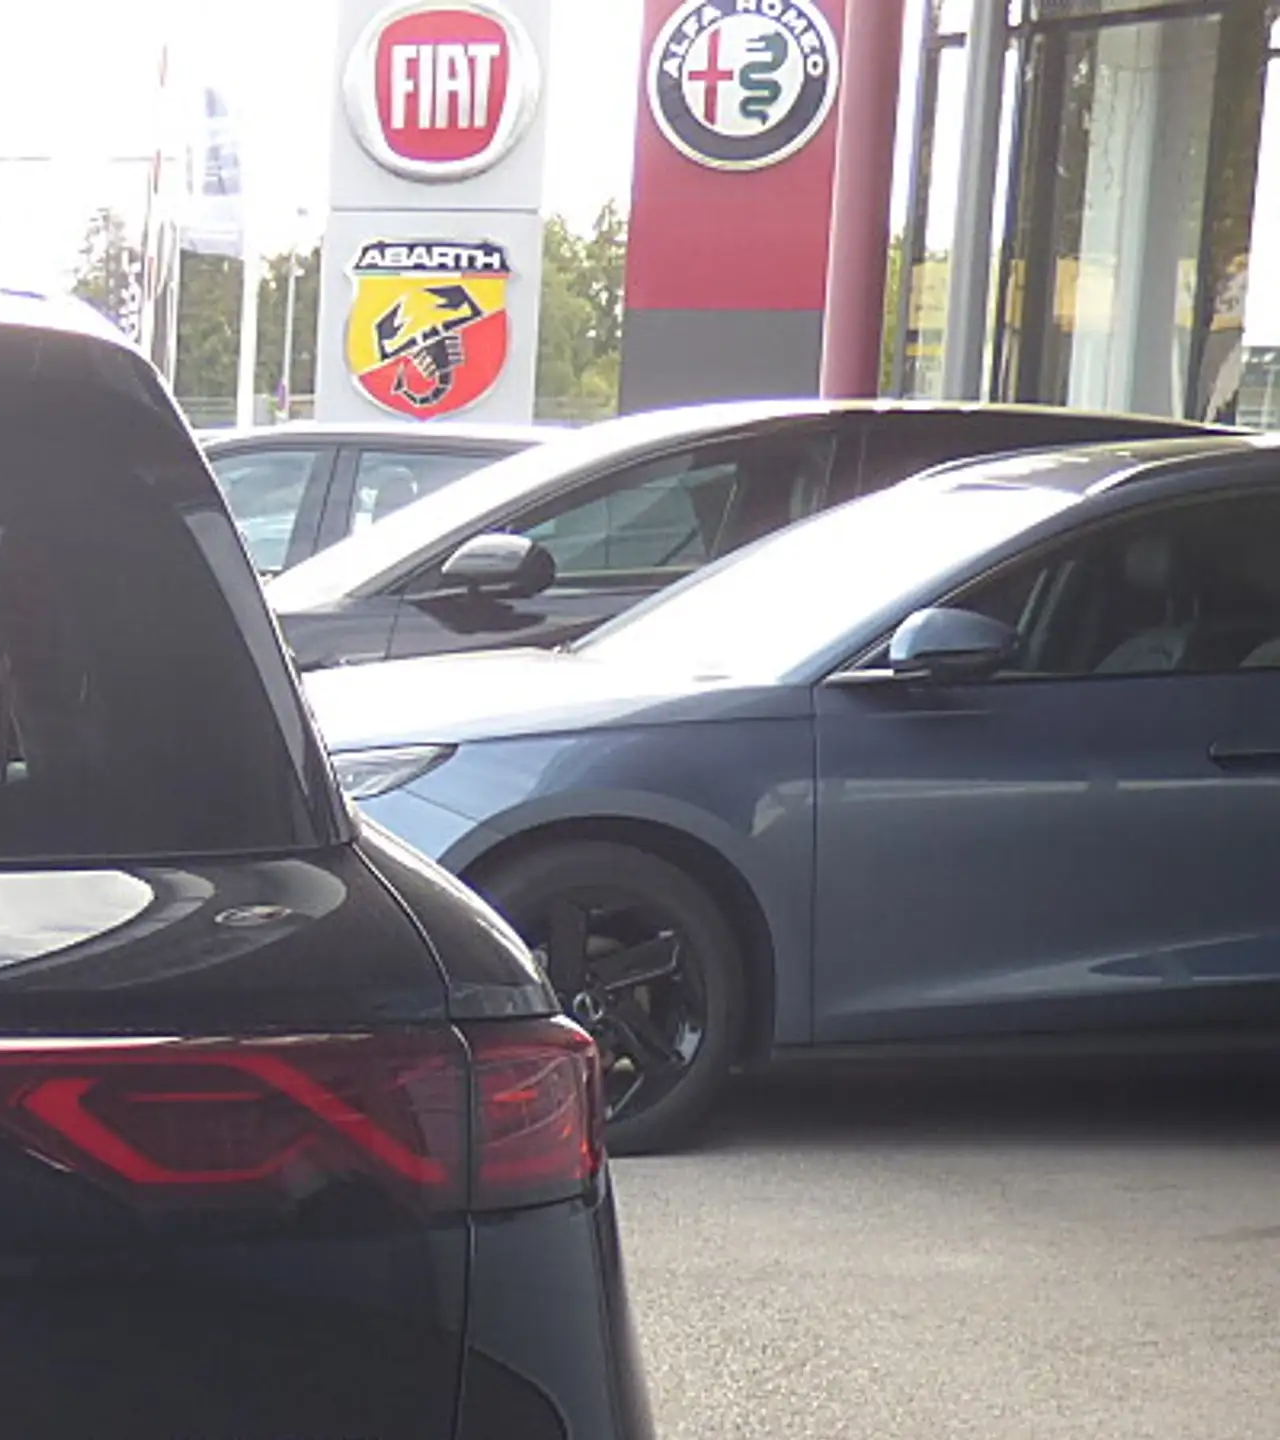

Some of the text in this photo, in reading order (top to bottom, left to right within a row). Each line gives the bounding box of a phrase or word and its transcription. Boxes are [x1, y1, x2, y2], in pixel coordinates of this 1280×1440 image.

[662, 4, 723, 80] ALFA
[391, 44, 500, 129] FIAT
[359, 246, 501, 269] ABARTH
